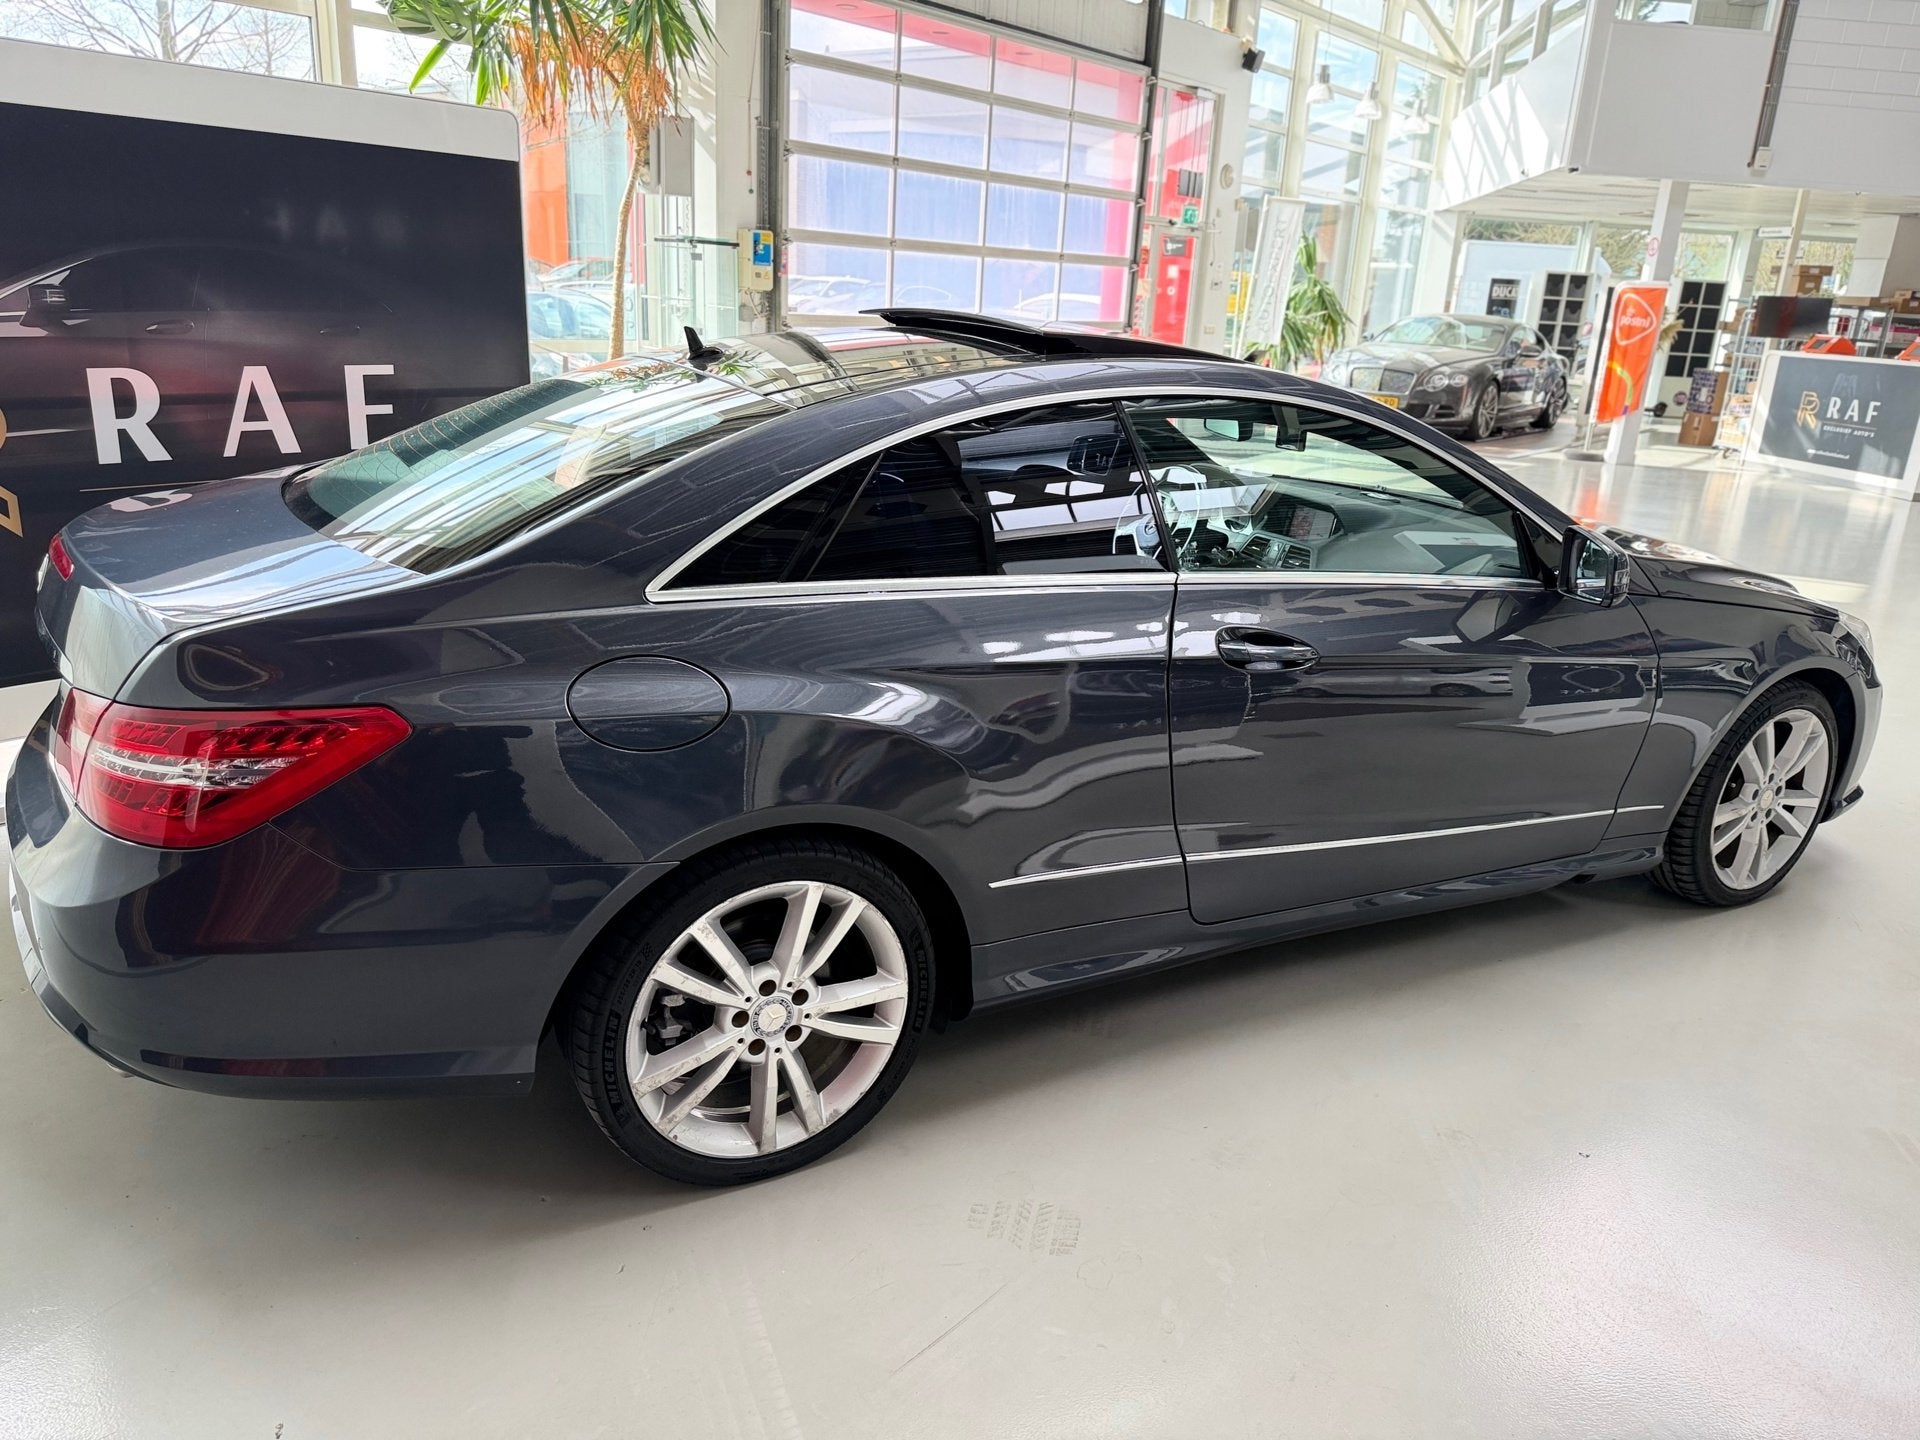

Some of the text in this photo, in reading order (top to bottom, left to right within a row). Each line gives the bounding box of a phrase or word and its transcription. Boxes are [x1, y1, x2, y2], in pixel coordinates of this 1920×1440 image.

[86, 364, 394, 465] RAF
[1825, 396, 1881, 424] RAF
[603, 1016, 620, 1105] MICHELIN
